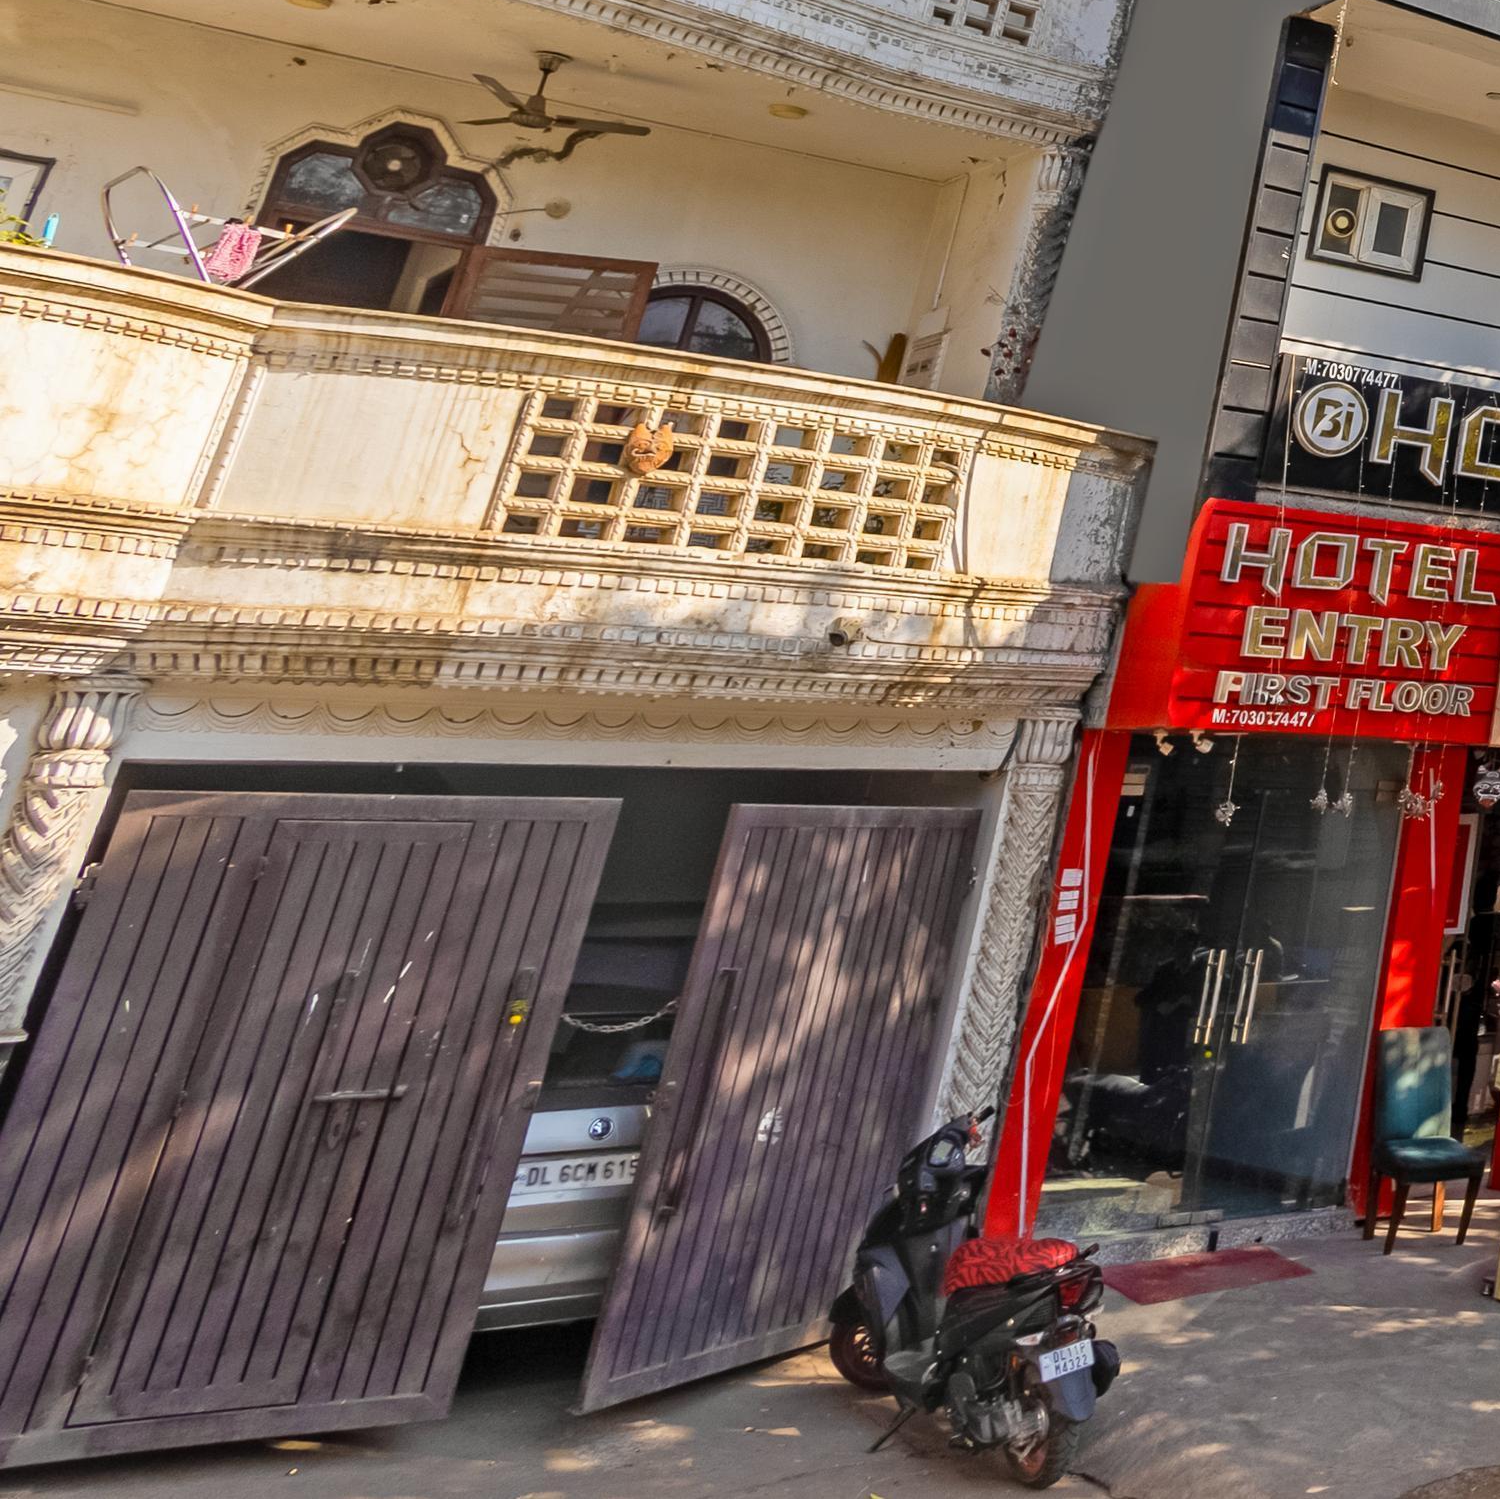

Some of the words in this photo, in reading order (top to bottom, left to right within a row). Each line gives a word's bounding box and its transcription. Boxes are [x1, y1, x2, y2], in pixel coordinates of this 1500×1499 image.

[1220, 522, 1496, 606] HOTEL
[1240, 605, 1468, 670] ENTRY
[1212, 670, 1340, 710] FIRST
[1345, 678, 1474, 717] FLOOR
[526, 1166, 552, 1187] DL
